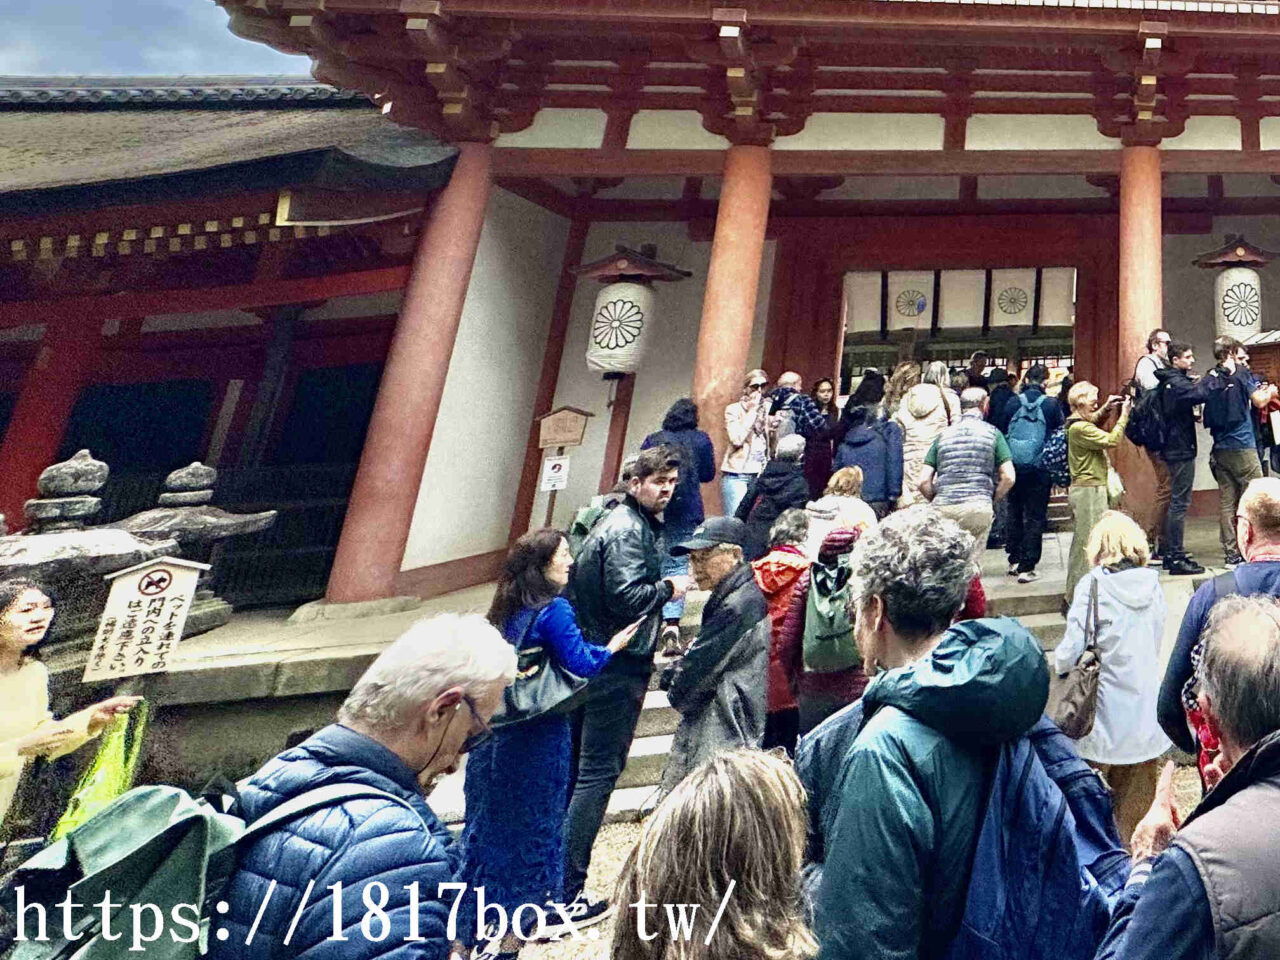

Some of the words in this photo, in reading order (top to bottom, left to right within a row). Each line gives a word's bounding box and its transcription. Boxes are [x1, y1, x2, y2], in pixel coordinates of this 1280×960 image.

[134, 597, 166, 666] 門内への立入り
